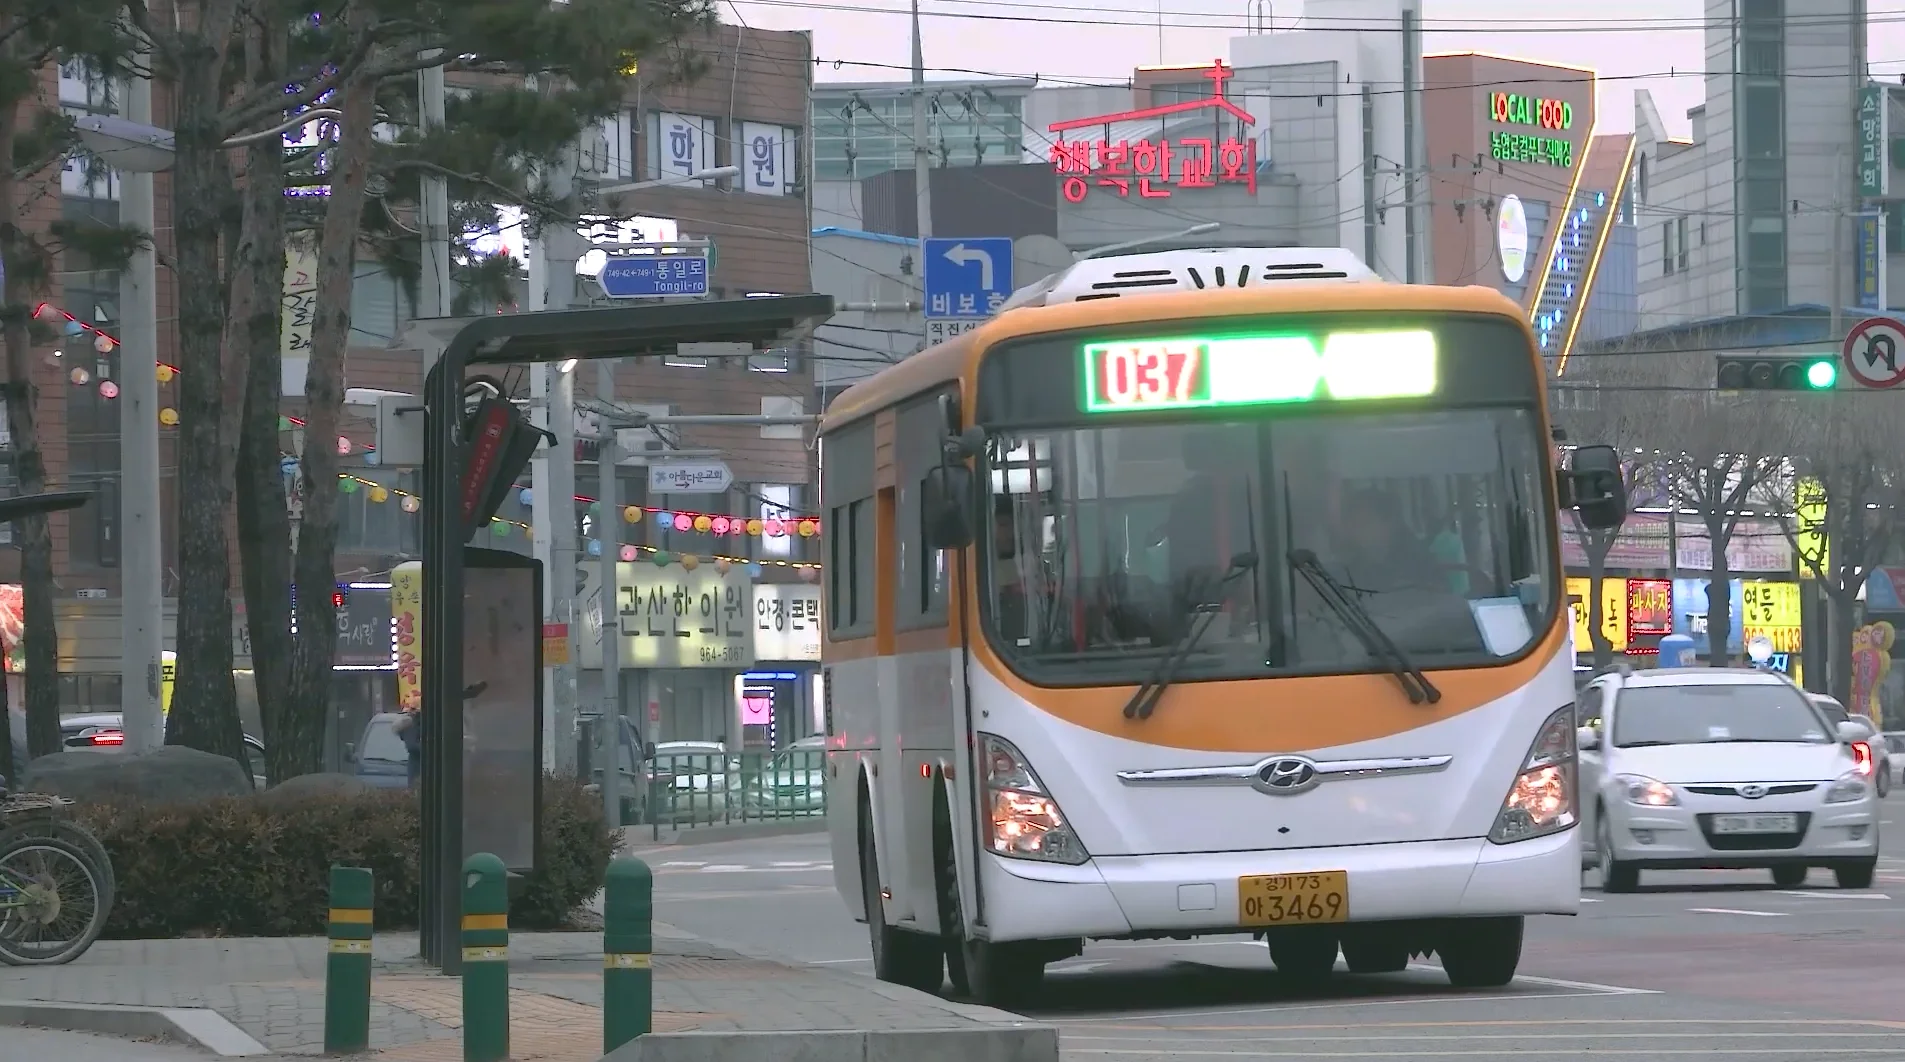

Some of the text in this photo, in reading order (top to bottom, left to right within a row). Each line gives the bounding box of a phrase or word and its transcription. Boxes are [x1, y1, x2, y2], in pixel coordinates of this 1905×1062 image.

[1490, 92, 1573, 130] LOCAL FOOD
[1491, 131, 1572, 168] 농협로컬푸드직매장
[656, 261, 704, 280] 통일로
[654, 281, 704, 293] Tongil-ro
[1103, 346, 1199, 403] 037
[619, 584, 744, 638] 관산한의원
[1632, 587, 1669, 616] 마사지
[699, 646, 744, 662] 964-5067
[1265, 875, 1321, 892] 경기 73
[1245, 891, 1343, 922] 아 3469
